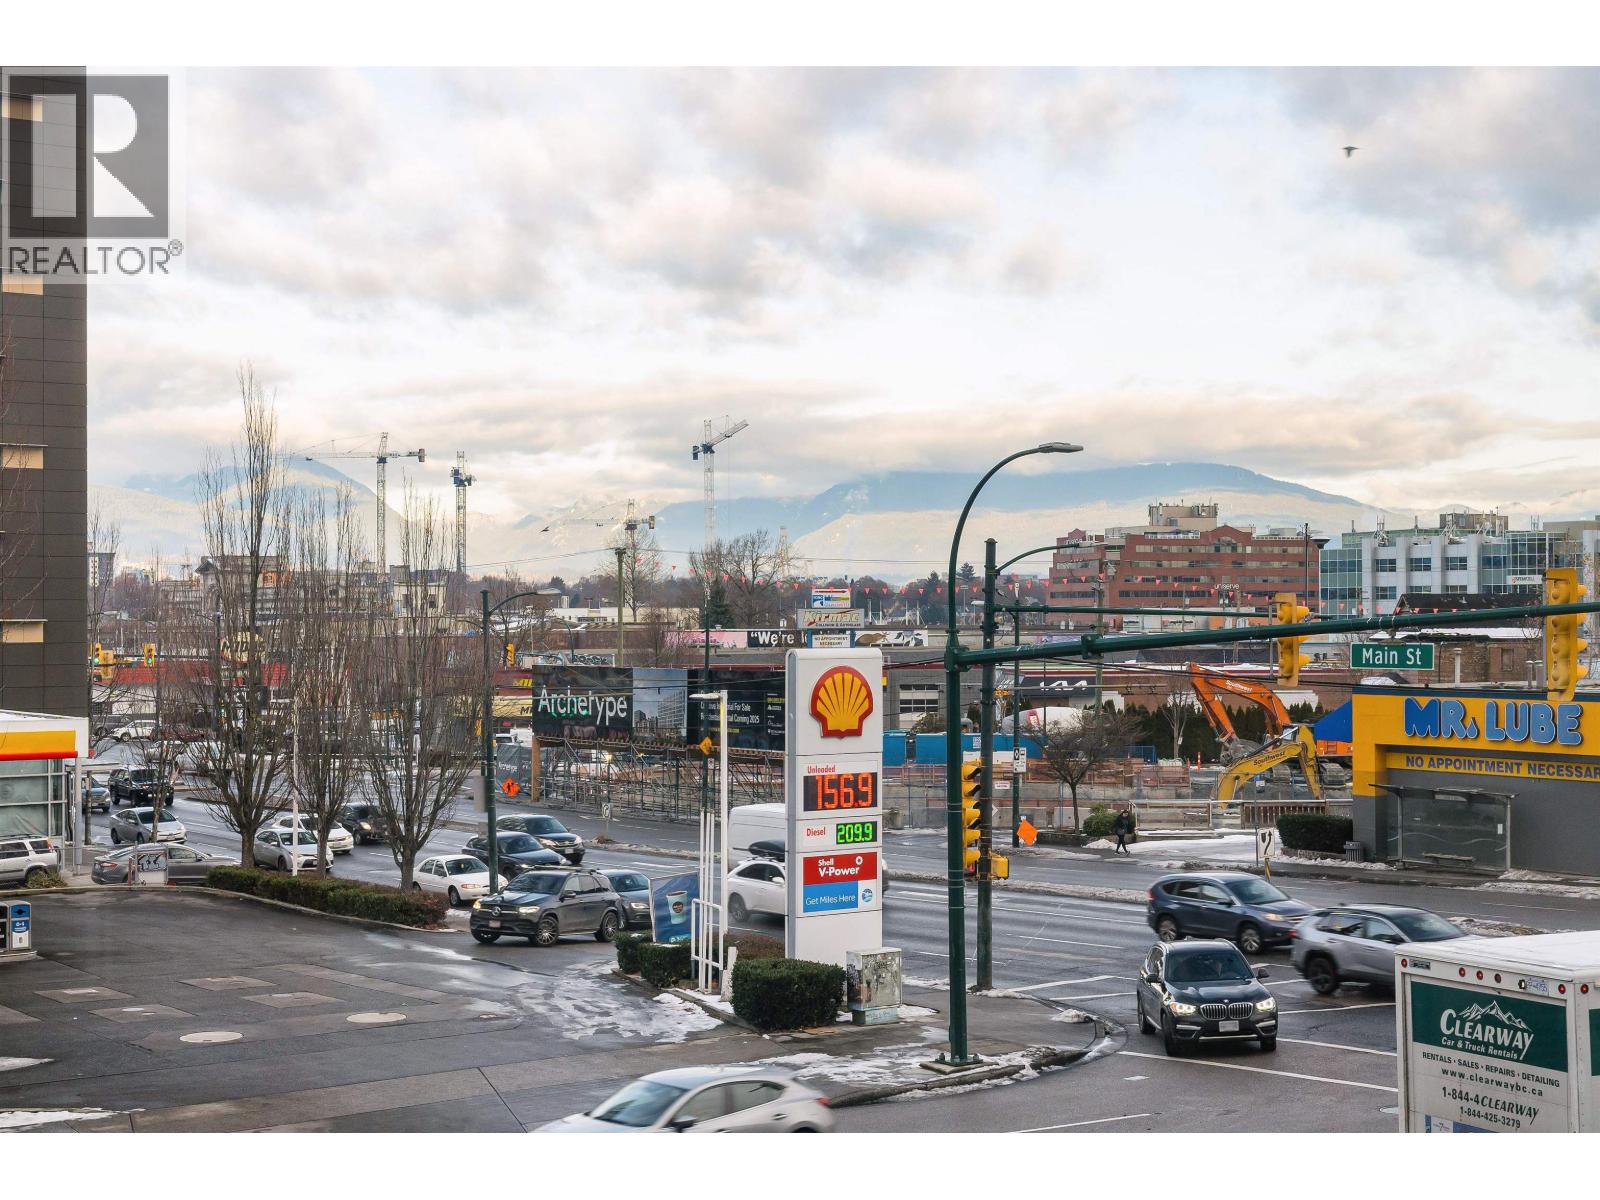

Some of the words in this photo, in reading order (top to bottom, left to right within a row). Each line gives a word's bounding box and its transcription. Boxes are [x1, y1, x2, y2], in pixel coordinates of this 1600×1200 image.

[1362, 647, 1398, 665] Main
[1406, 647, 1422, 665] St
[1225, 680, 1253, 693] Southwest
[538, 685, 627, 726] Archetype
[742, 703, 751, 712] Sale
[749, 714, 760, 724] 2025
[1485, 701, 1584, 745] LUBE
[1253, 751, 1286, 766] Southwest
[1405, 755, 1424, 769] NO
[1427, 757, 1523, 775] APPOINTMENT
[807, 765, 836, 774] Unleaded
[815, 772, 873, 811] 156.9
[807, 827, 826, 837] Diesel
[837, 822, 873, 843] 209.9
[818, 858, 834, 867] Shell
[818, 866, 860, 878] V-Power
[805, 896, 819, 906] Get
[820, 895, 838, 905] Miles
[838, 894, 856, 904] Here
[1440, 1008, 1535, 1061] CLEARWAY
[1441, 1036, 1455, 1046] Car
[1457, 1039, 1464, 1048] &
[1465, 1041, 1485, 1053] Truck
[1488, 1045, 1518, 1060] Rentals
[1422, 1051, 1452, 1064] RENTALS
[1457, 1058, 1480, 1070] SALES
[1485, 1064, 1515, 1078] REPAIRS
[1521, 1072, 1560, 1088] DETAILING
[1441, 1068, 1543, 1097] www.clearwaybc.ca
[1442, 1086, 1540, 1126] 1-844-4CLEARWAY
[1460, 1106, 1521, 1128] 1-844-425-3279
